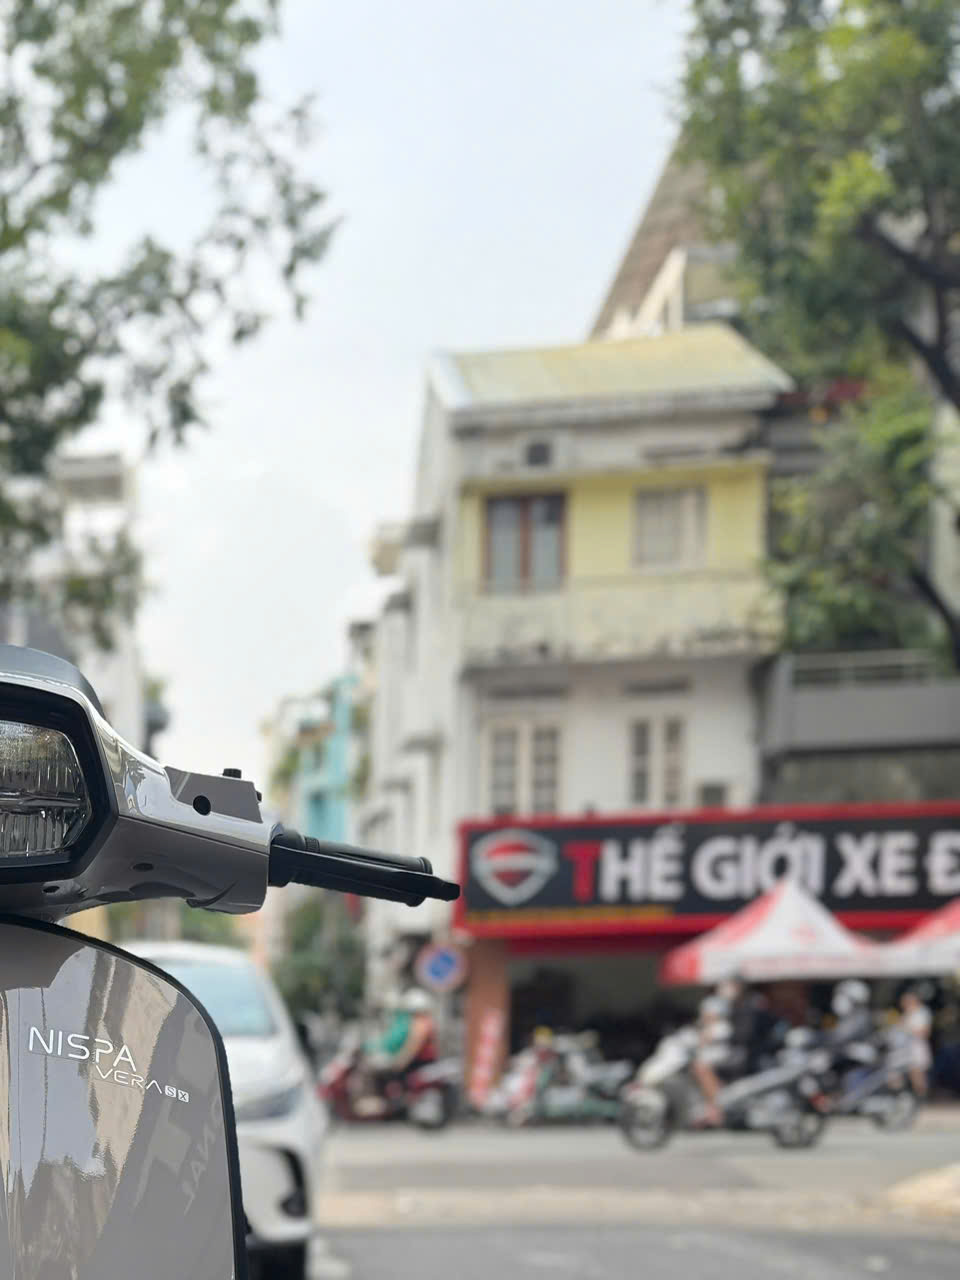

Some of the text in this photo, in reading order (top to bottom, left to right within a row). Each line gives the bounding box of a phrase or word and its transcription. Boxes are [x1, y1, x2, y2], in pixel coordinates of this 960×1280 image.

[833, 831, 918, 897] XE
[28, 1026, 137, 1073] NISPA
[95, 1064, 163, 1095] VERA
